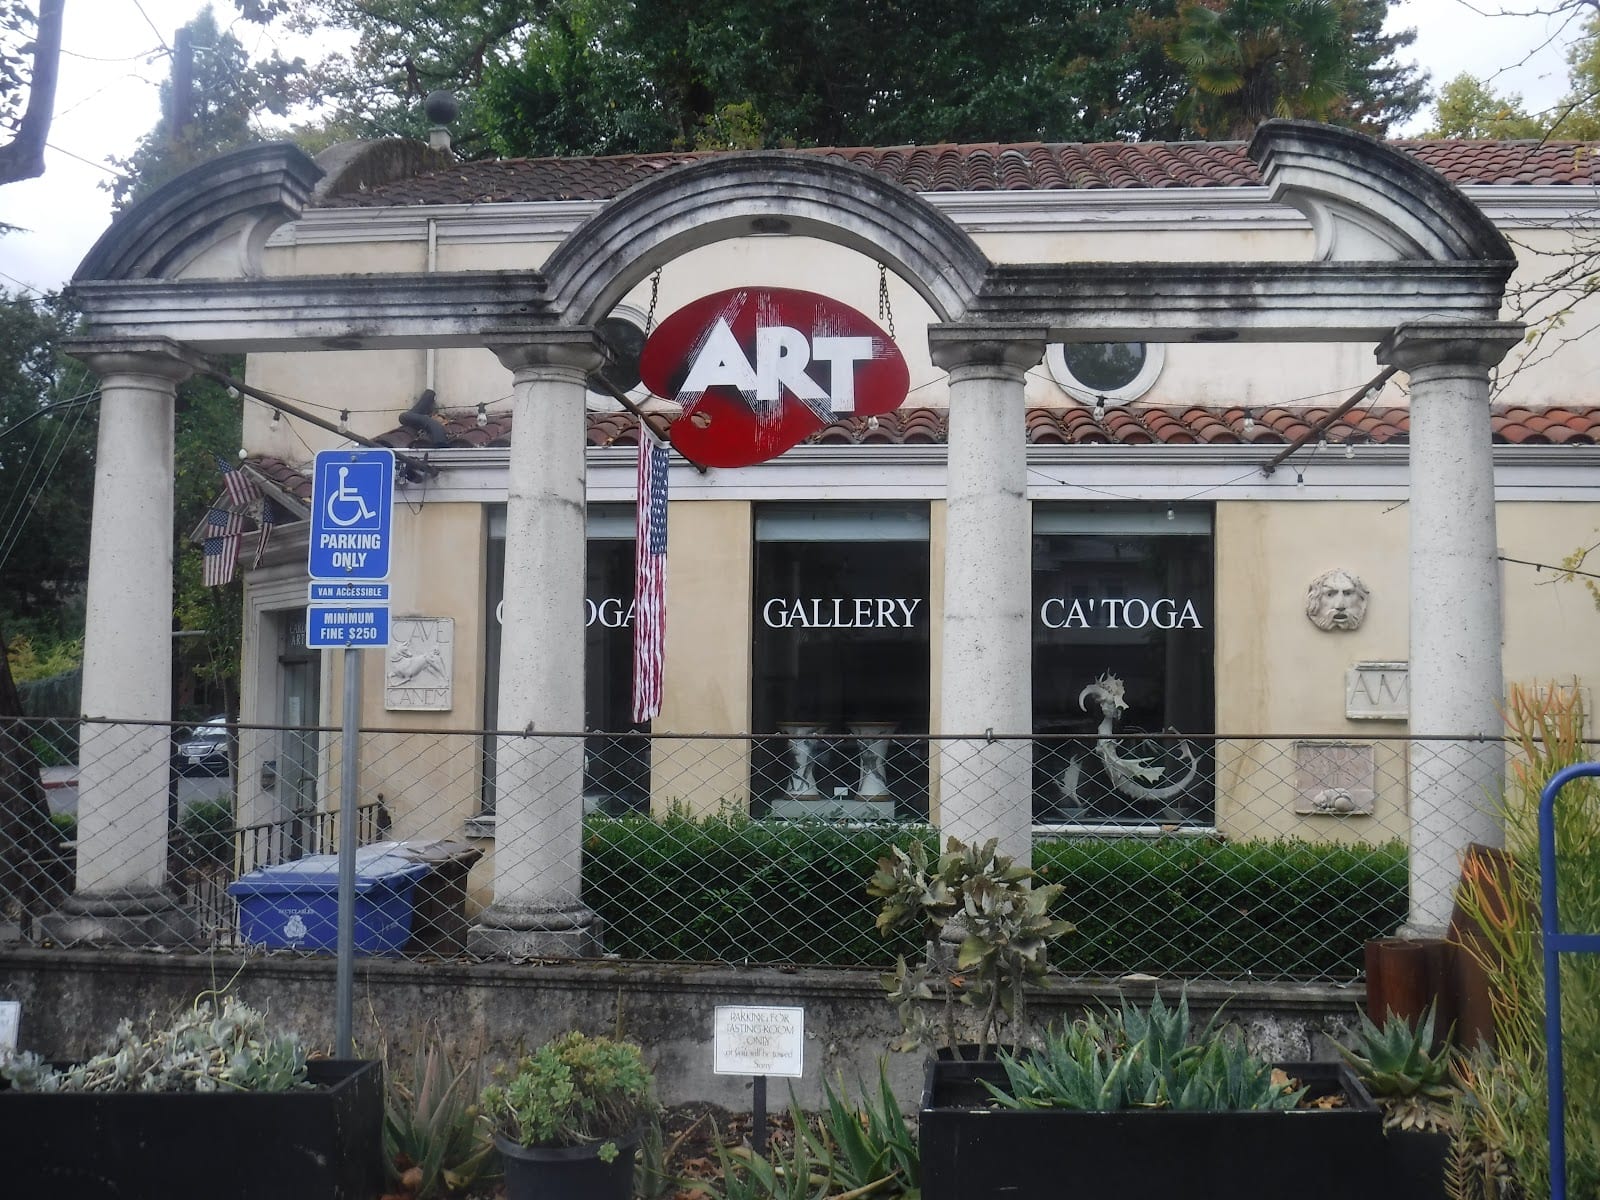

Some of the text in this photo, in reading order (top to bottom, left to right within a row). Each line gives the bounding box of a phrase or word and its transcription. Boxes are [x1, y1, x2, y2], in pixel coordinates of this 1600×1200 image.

[676, 316, 873, 412] ART
[320, 534, 381, 549] PARKING
[332, 552, 367, 568] ONLY
[318, 588, 382, 596] VAN ACCESSIBLE
[324, 612, 374, 624] MINIMUM
[763, 598, 922, 628] GALLERY
[1040, 598, 1203, 629] CA'TOGA
[320, 627, 377, 639] FINE $250
[392, 621, 450, 643] CAVE
[731, 1011, 789, 1023] PARKING FOR
[727, 1023, 794, 1034] TASTING ROOM
[746, 1036, 769, 1046] ONLY
